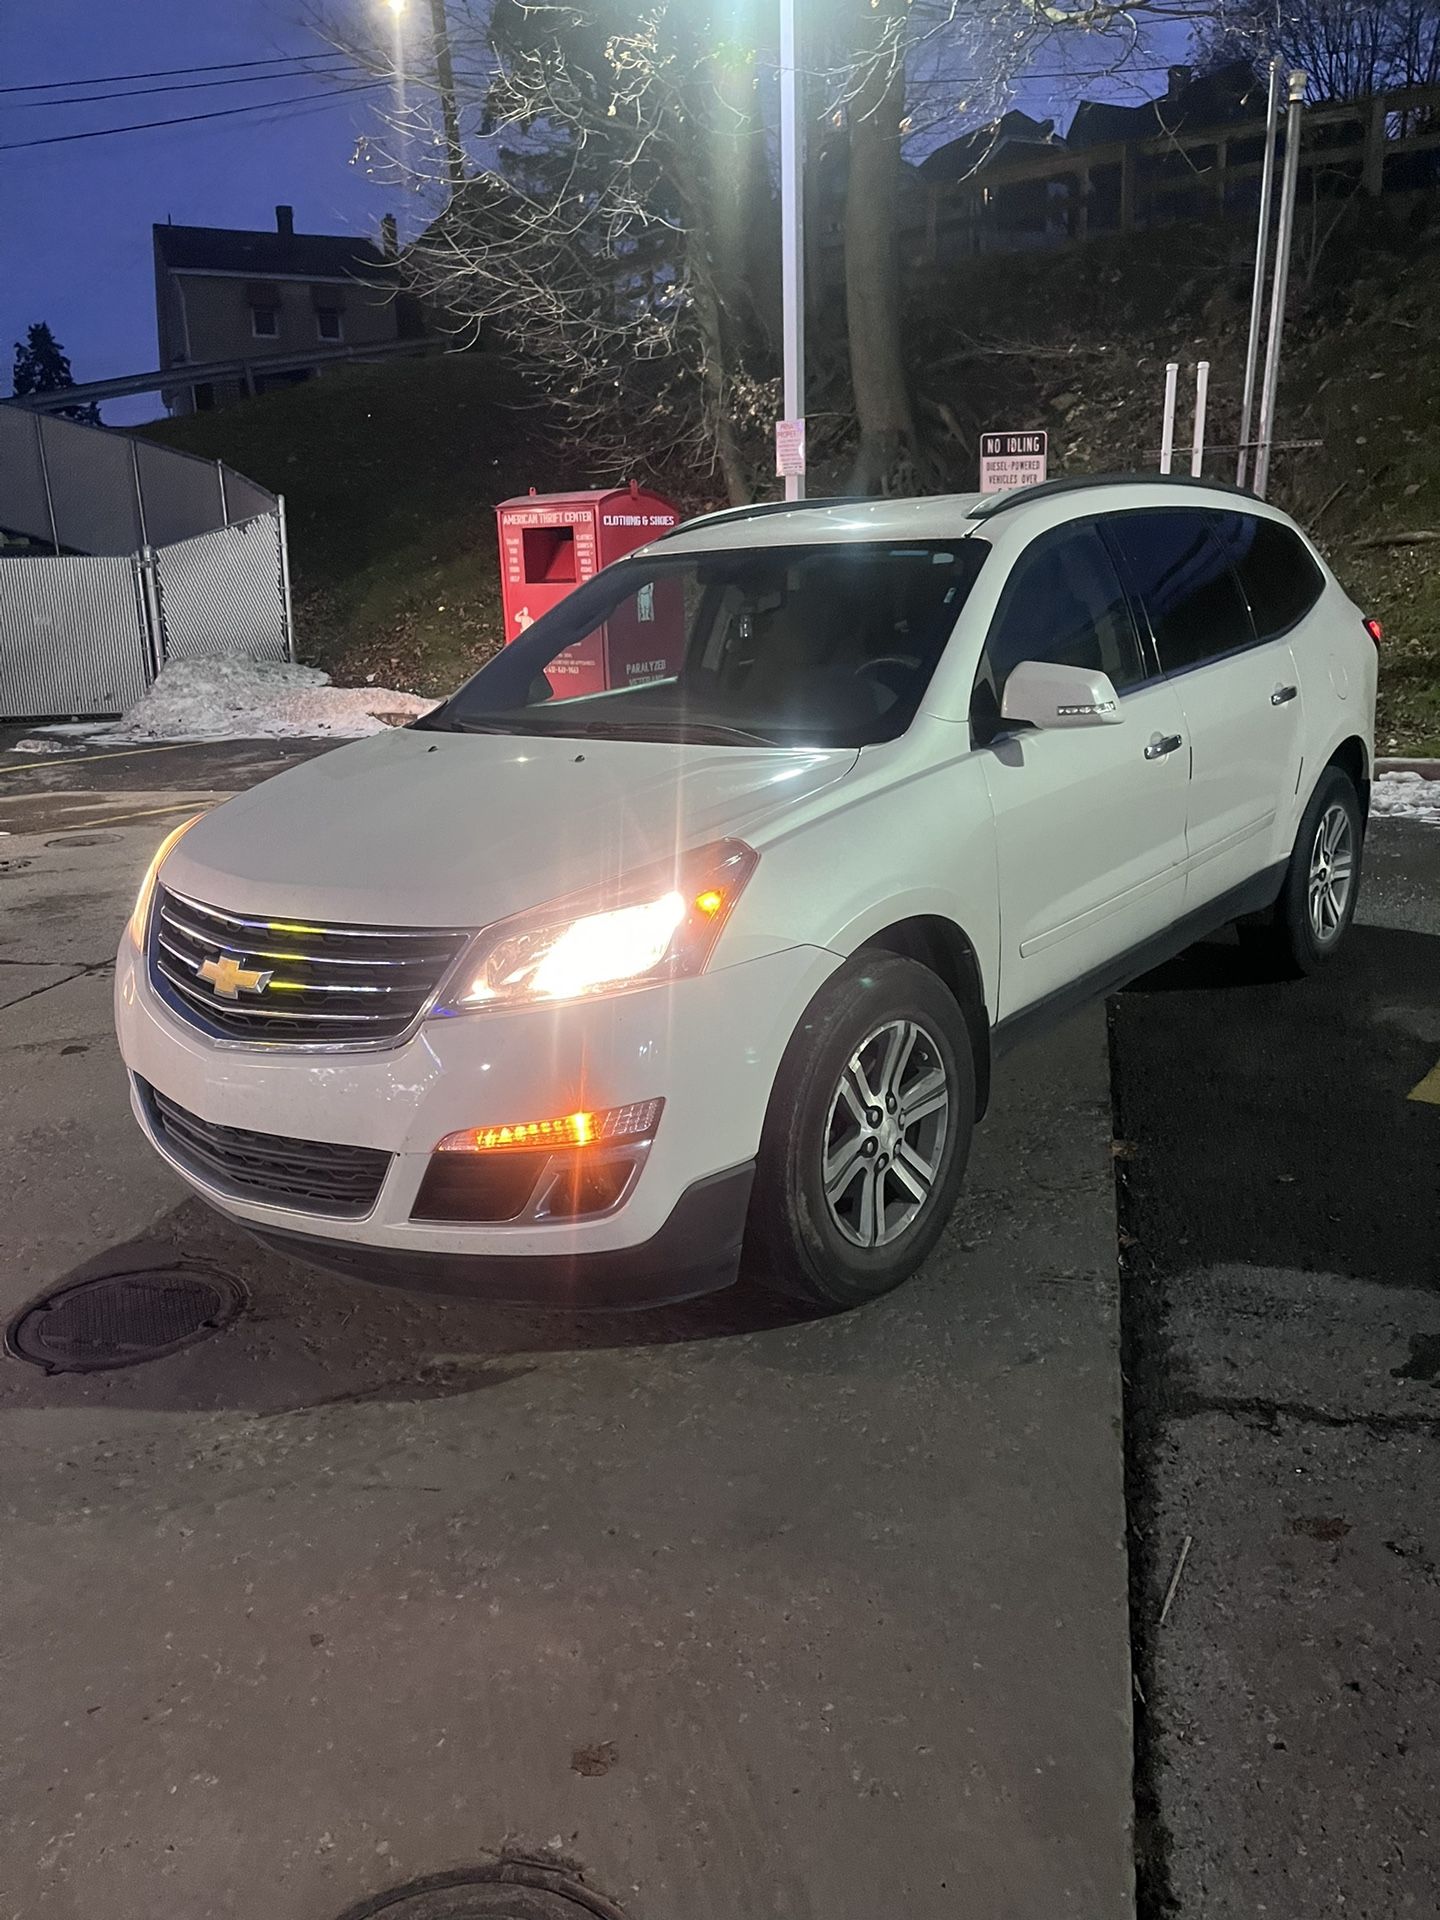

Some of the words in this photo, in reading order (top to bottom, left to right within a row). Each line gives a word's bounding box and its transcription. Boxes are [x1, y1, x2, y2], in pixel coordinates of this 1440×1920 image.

[987, 438, 1001, 454] NO
[1007, 436, 1040, 453] IDLING
[986, 460, 1040, 471] DIESEL-POWERED
[989, 474, 1017, 485] VEHICLES
[1021, 474, 1038, 484] OVER
[503, 513, 538, 525] AMERICAN
[539, 512, 563, 524] THRIFT
[564, 511, 592, 523] CENTER
[603, 515, 641, 526] CLOTHING
[642, 515, 649, 526] &
[649, 515, 675, 526] SHOES
[626, 659, 666, 675] PARALYZED
